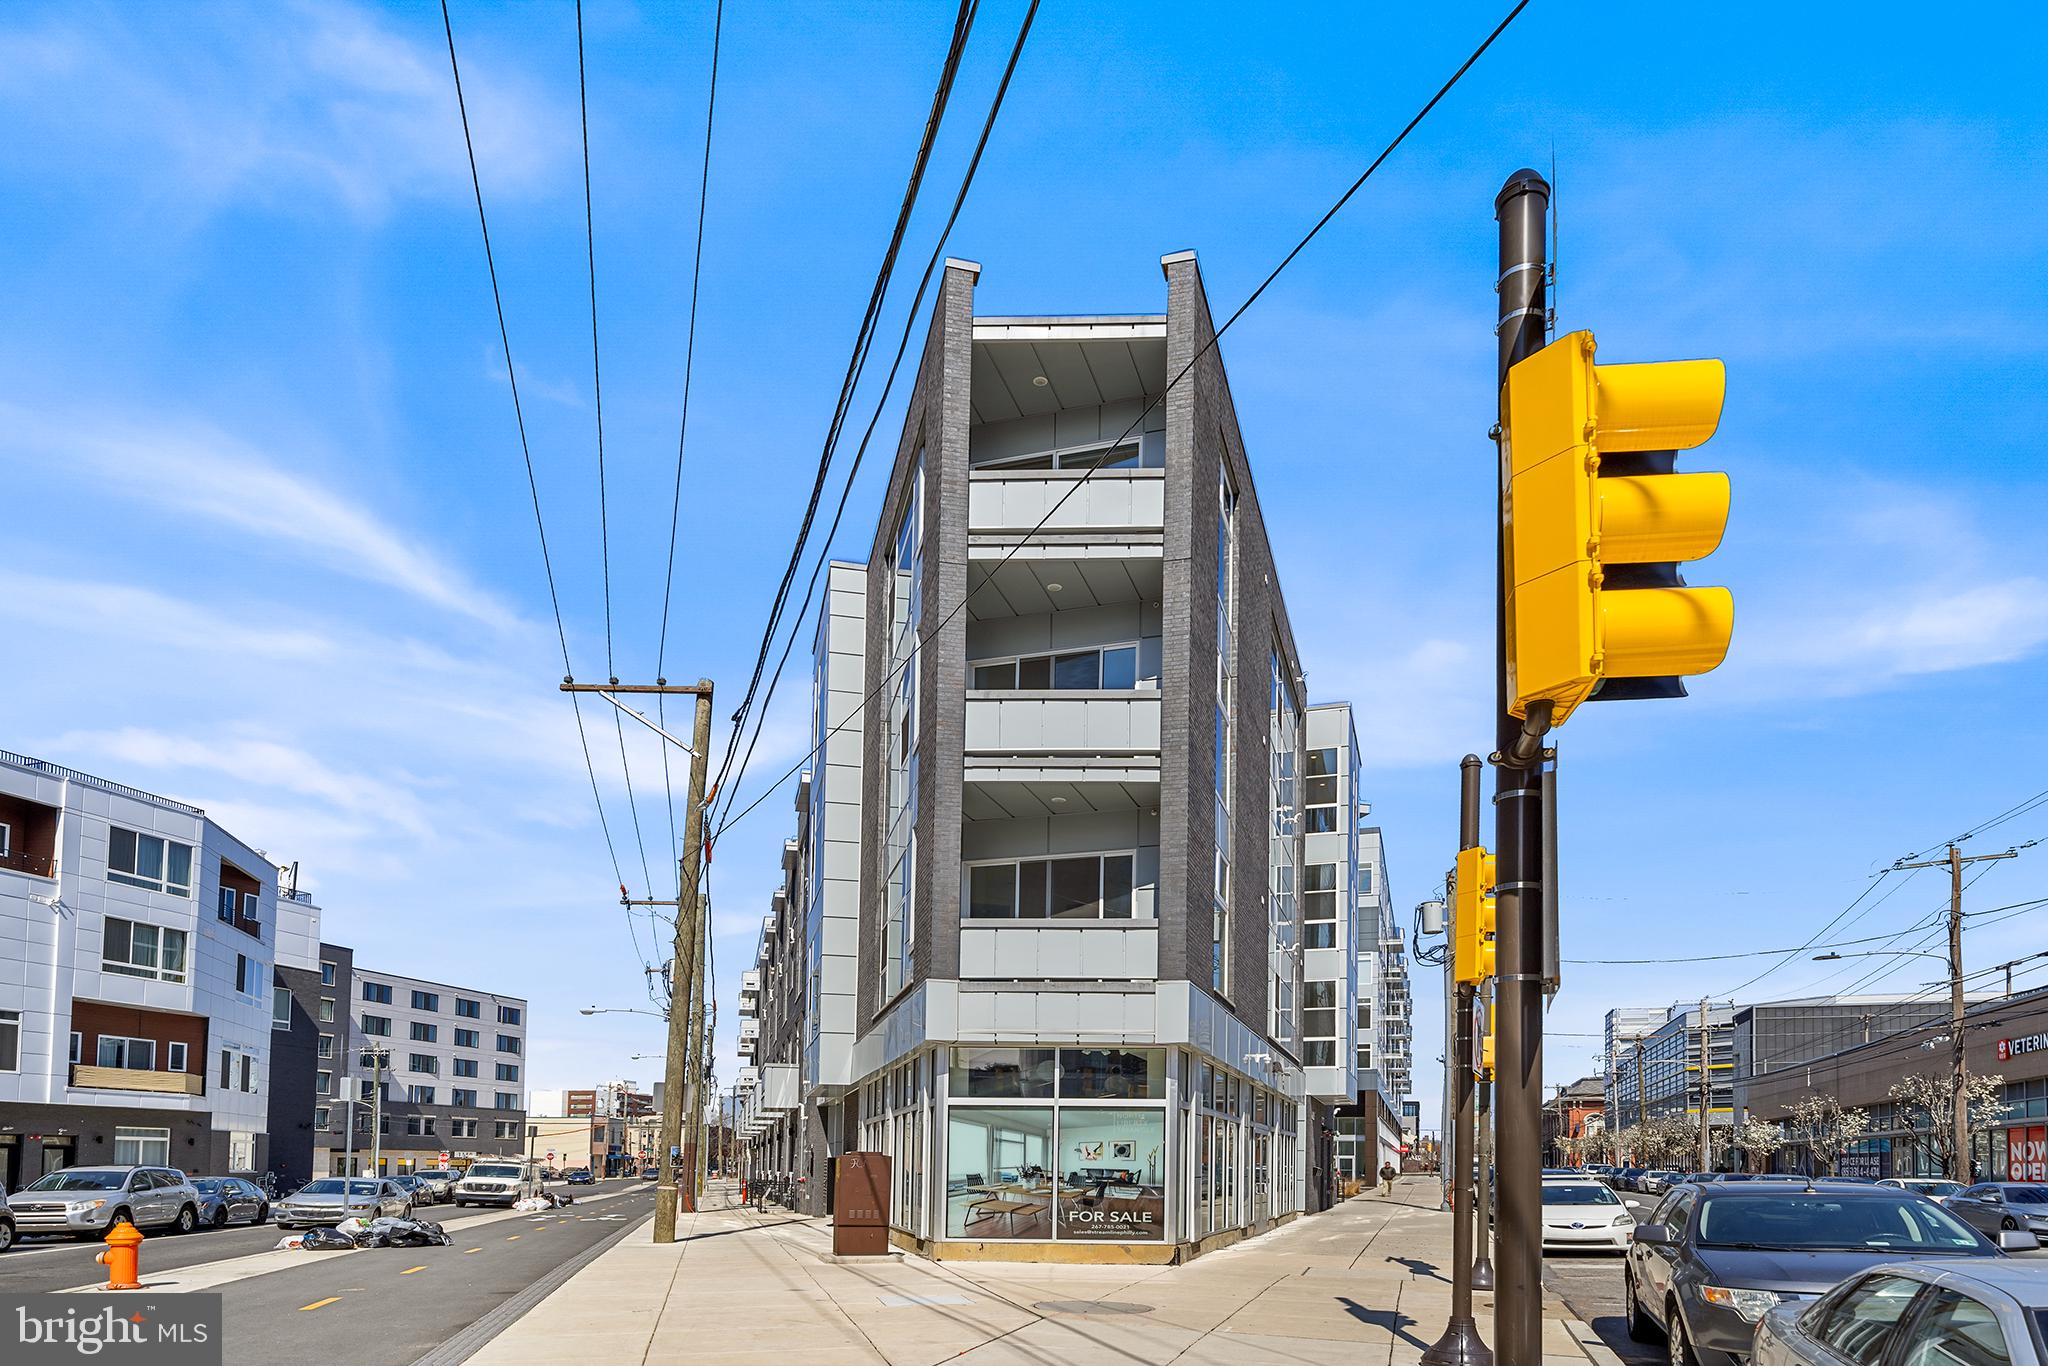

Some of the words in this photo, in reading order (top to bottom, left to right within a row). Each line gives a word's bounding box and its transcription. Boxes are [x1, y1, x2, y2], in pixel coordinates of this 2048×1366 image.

[2011, 1141, 2047, 1161] NOW
[1069, 1211, 1104, 1222] FOR
[1110, 1211, 1152, 1223] SALE
